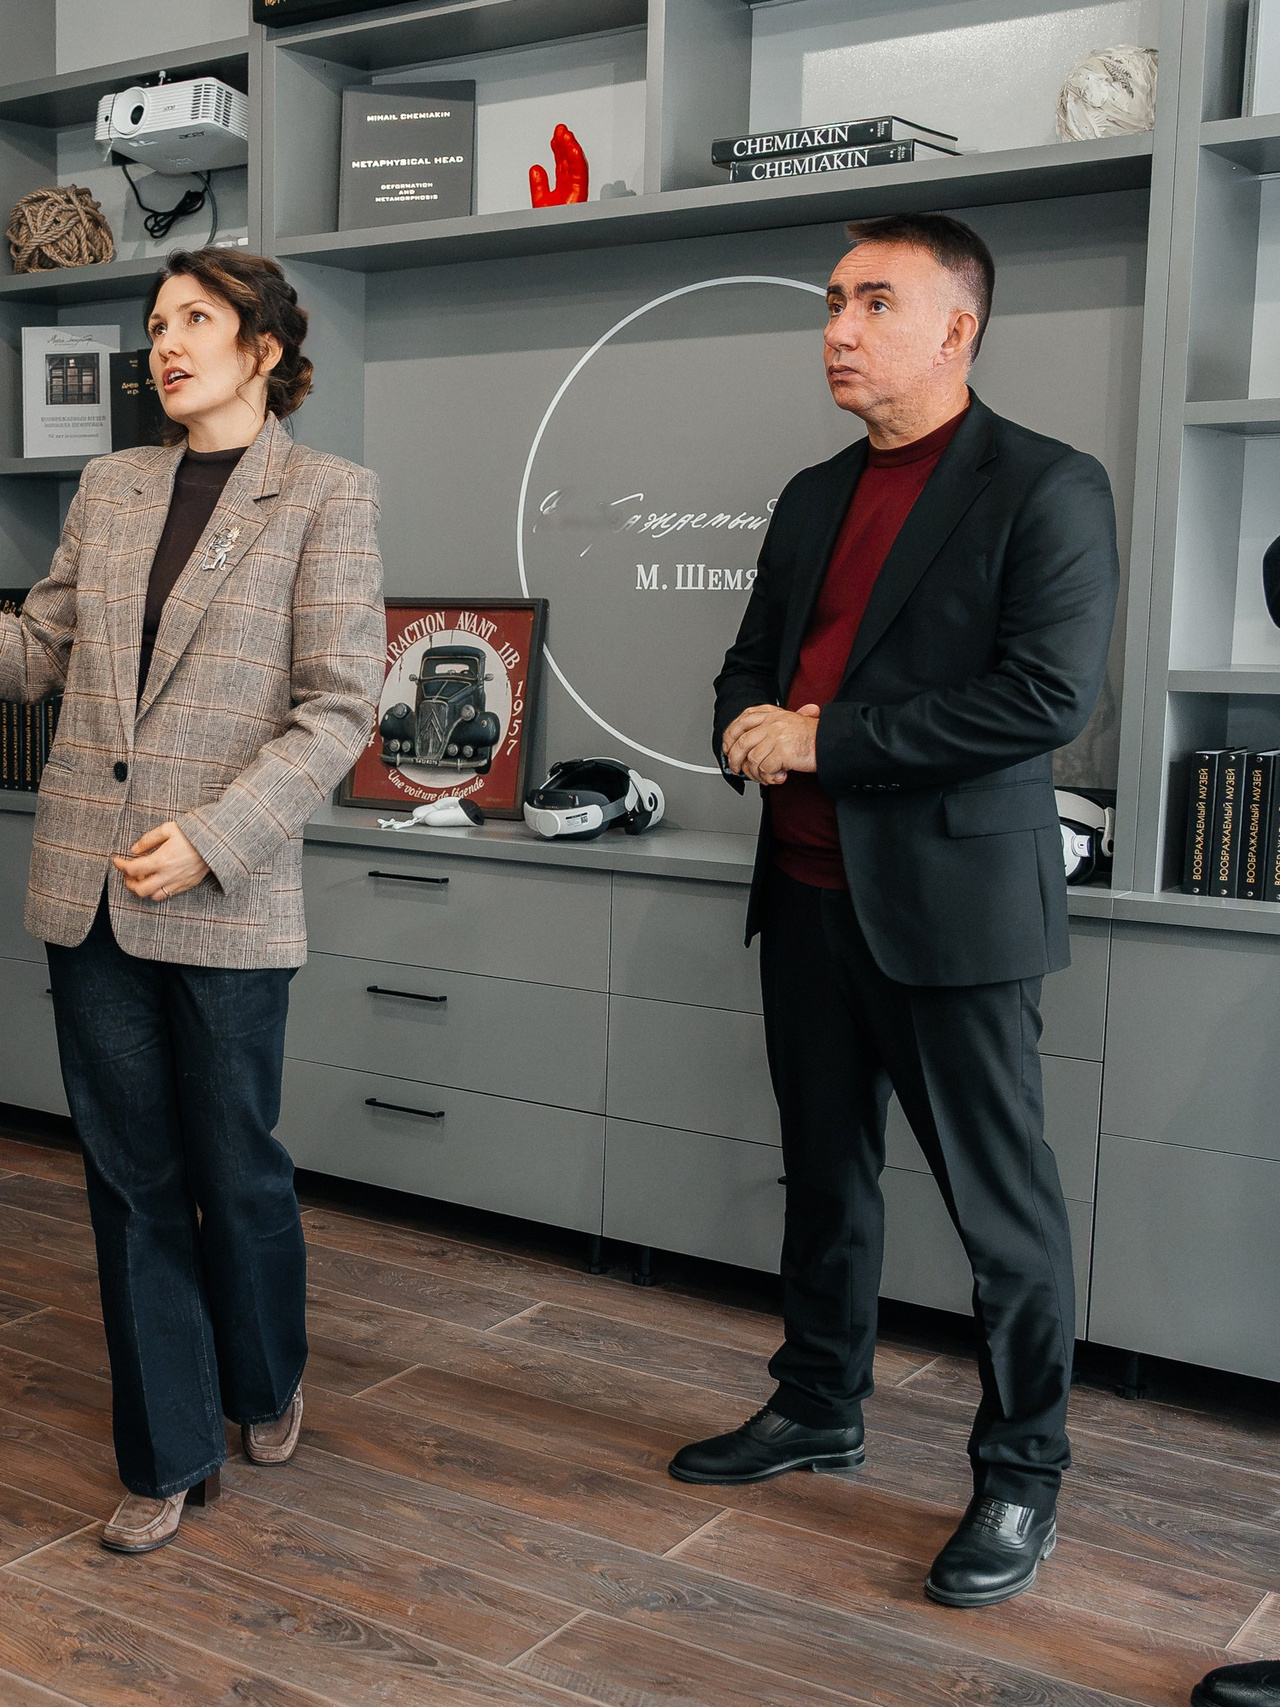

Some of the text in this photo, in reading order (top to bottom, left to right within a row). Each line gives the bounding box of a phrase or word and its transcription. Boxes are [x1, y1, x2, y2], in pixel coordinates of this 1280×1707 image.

[367, 111, 451, 122] MIHAIL CHEMIAKIN
[733, 125, 850, 157] CHEMIAKIN
[351, 156, 464, 169] METAPHYSICAL HEAD
[751, 150, 870, 181] CHEMIAKIN
[636, 564, 668, 590] М.
[455, 611, 499, 642] AVANT
[497, 641, 521, 670] 11B
[387, 768, 404, 790] Une
[404, 785, 438, 801] voiture
[1192, 768, 1208, 880] ВООБРАЖАЕМЫЙ МУЗЕЙ
[1219, 768, 1236, 881] ВООБРАЖАЕМЫЙ МУЗЕЙ
[1246, 769, 1262, 884] ВООБРАЖАЕМЫЙ МУЗЕЙ
